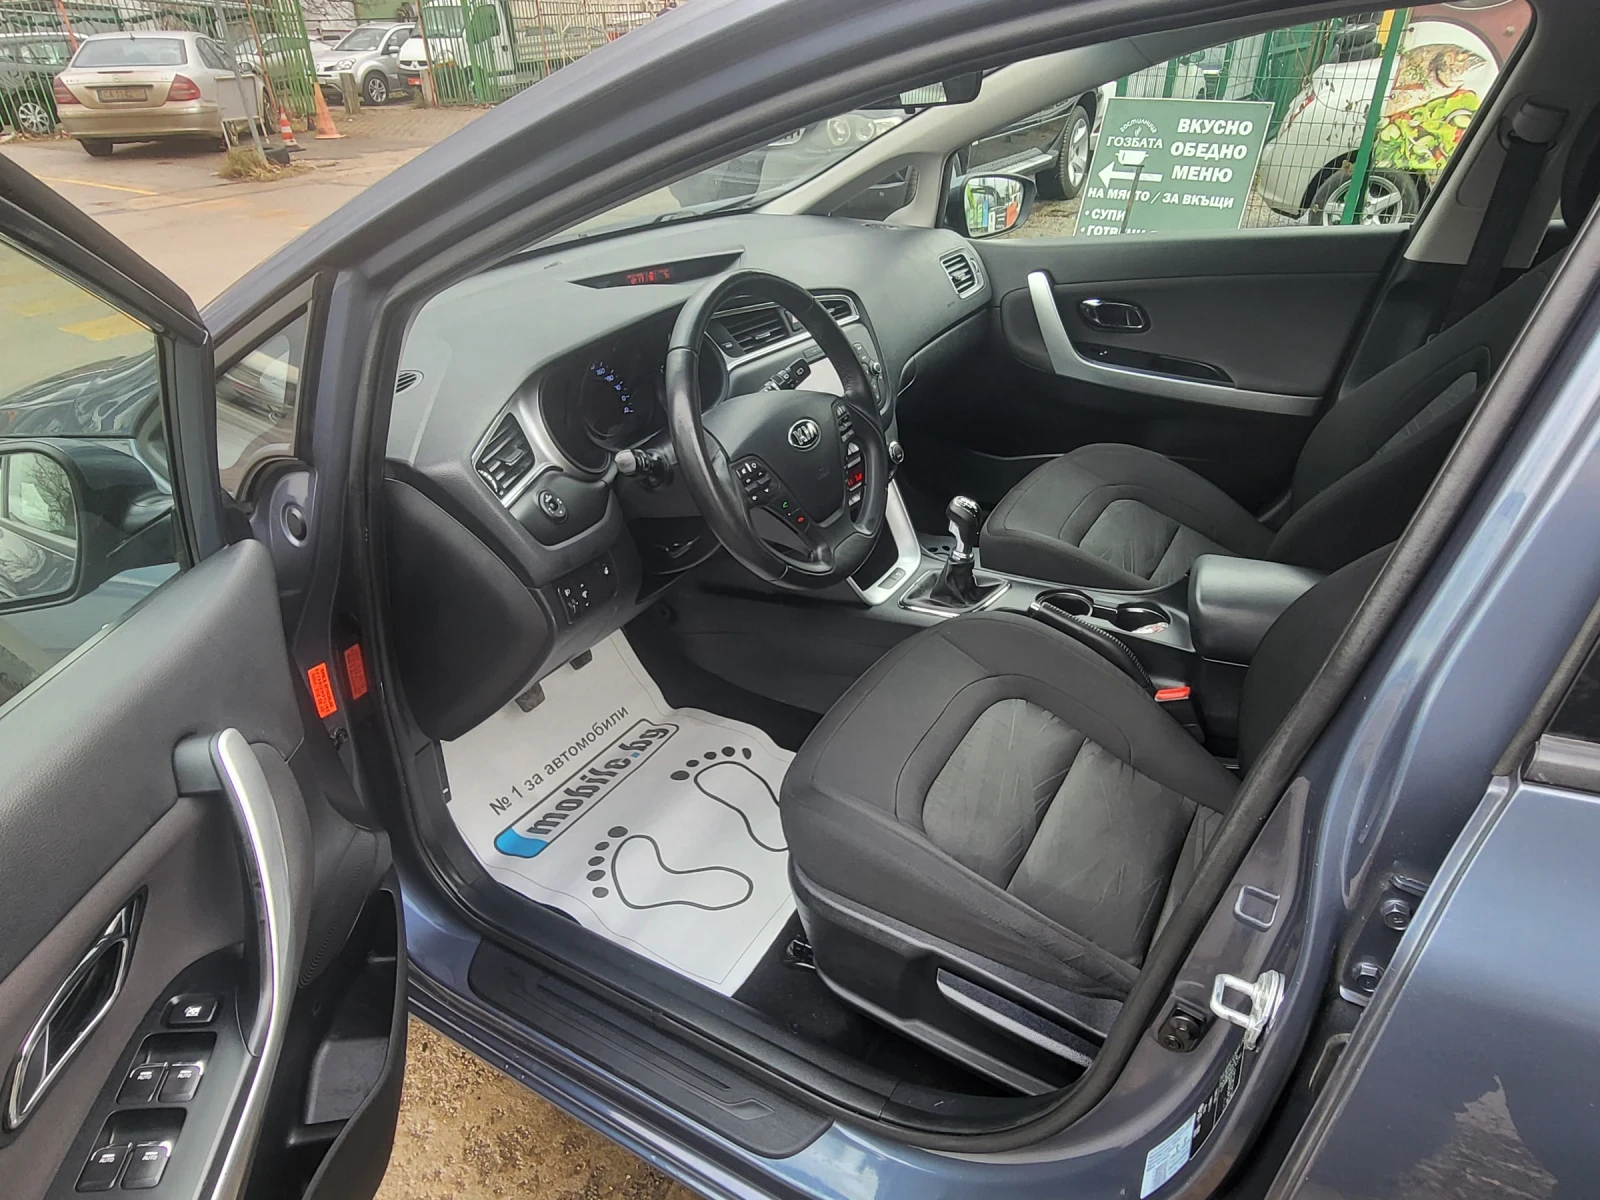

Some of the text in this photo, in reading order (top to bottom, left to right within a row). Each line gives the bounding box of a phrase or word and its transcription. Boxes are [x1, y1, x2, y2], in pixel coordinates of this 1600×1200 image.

[1177, 118, 1253, 135] ВКУСНО
[1106, 136, 1163, 148] ГОЗБАТА
[1170, 141, 1247, 160] ОБЕДНО
[1171, 165, 1233, 183] МЕНЮ
[1087, 187, 1104, 199] НА
[1162, 192, 1179, 204] ЗА
[1182, 194, 1234, 209] ВКЪЩИ
[511, 785, 523, 799] 1
[524, 773, 544, 791] за
[544, 706, 629, 775] автомобили
[526, 728, 669, 835] mobile.bg
